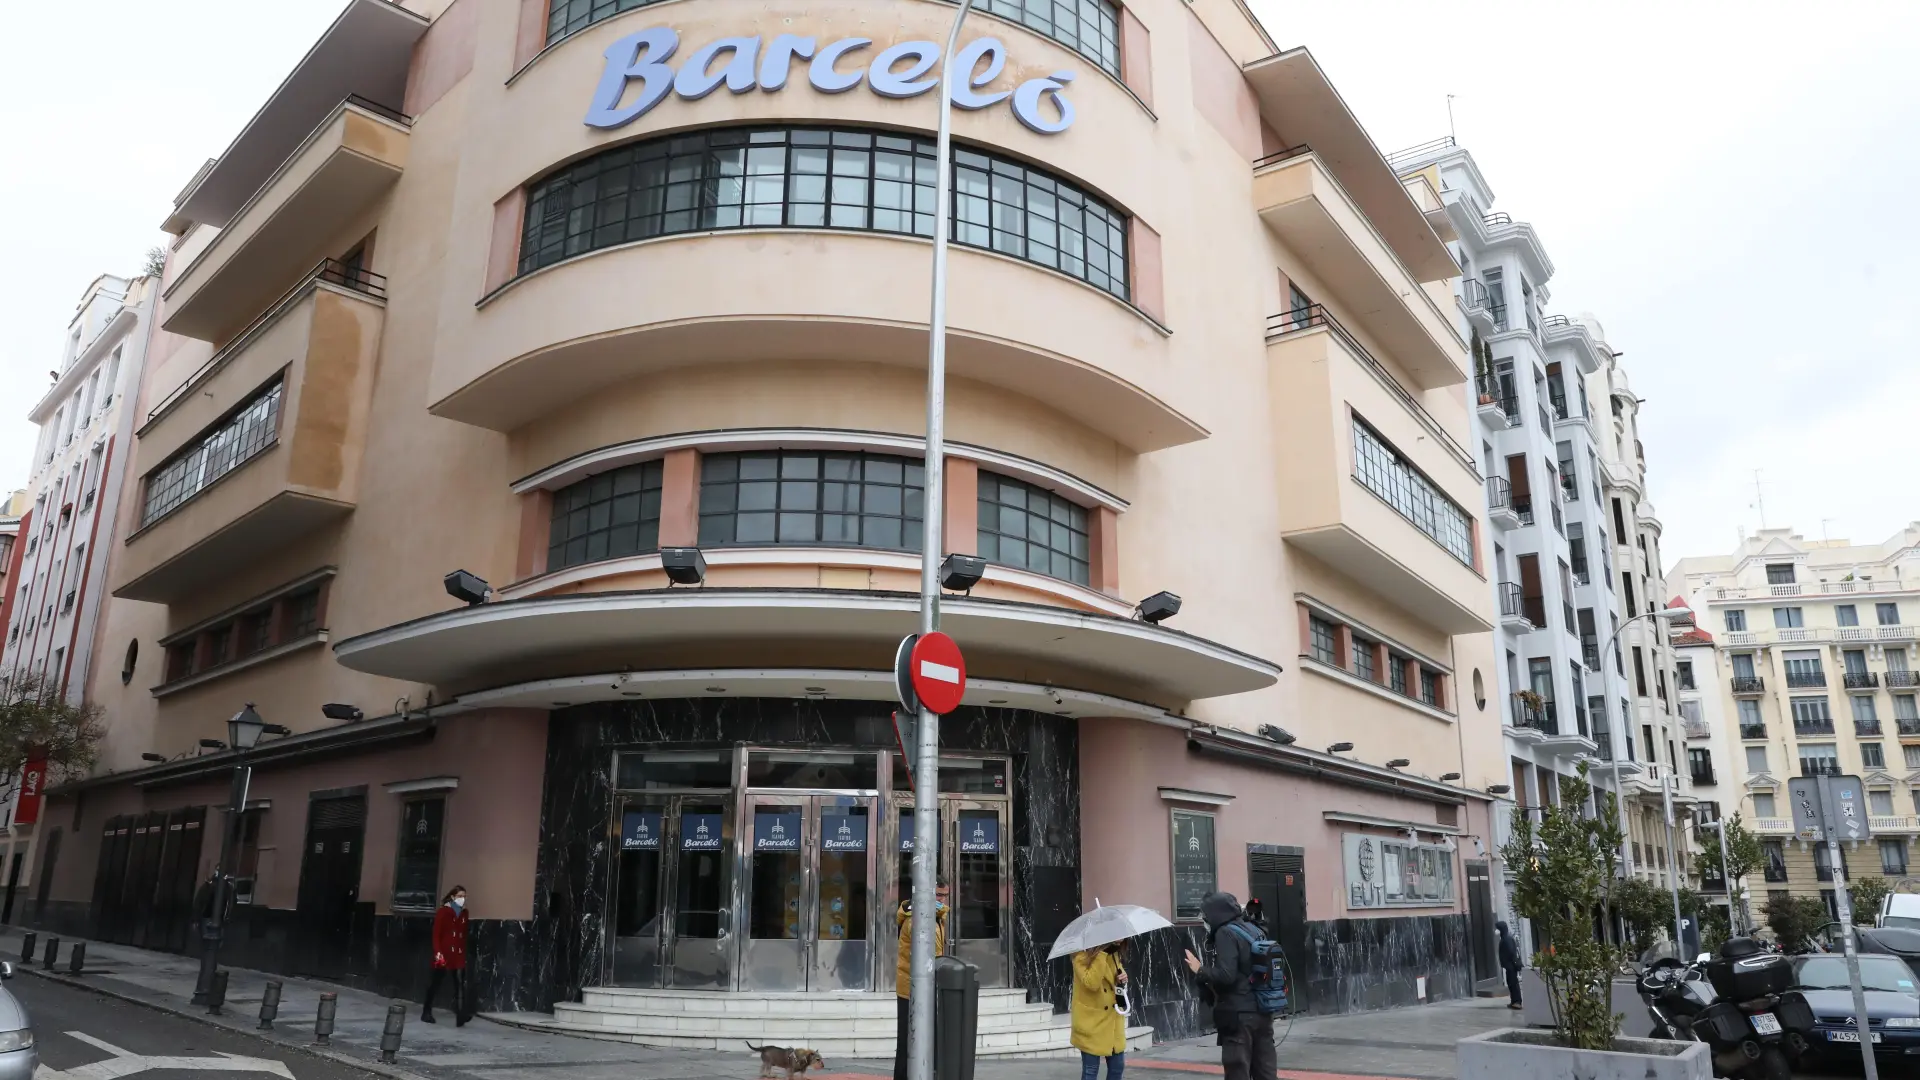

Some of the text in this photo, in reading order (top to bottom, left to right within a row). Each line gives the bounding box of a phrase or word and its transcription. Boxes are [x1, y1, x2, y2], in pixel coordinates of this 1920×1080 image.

[584, 27, 1077, 134] Barceló
[625, 837, 659, 847] Barceló
[684, 838, 719, 848] Barceló
[758, 838, 796, 847] Barceló
[825, 839, 863, 848] Barceló
[962, 842, 995, 850] Barceló
[1681, 919, 1690, 930] P
